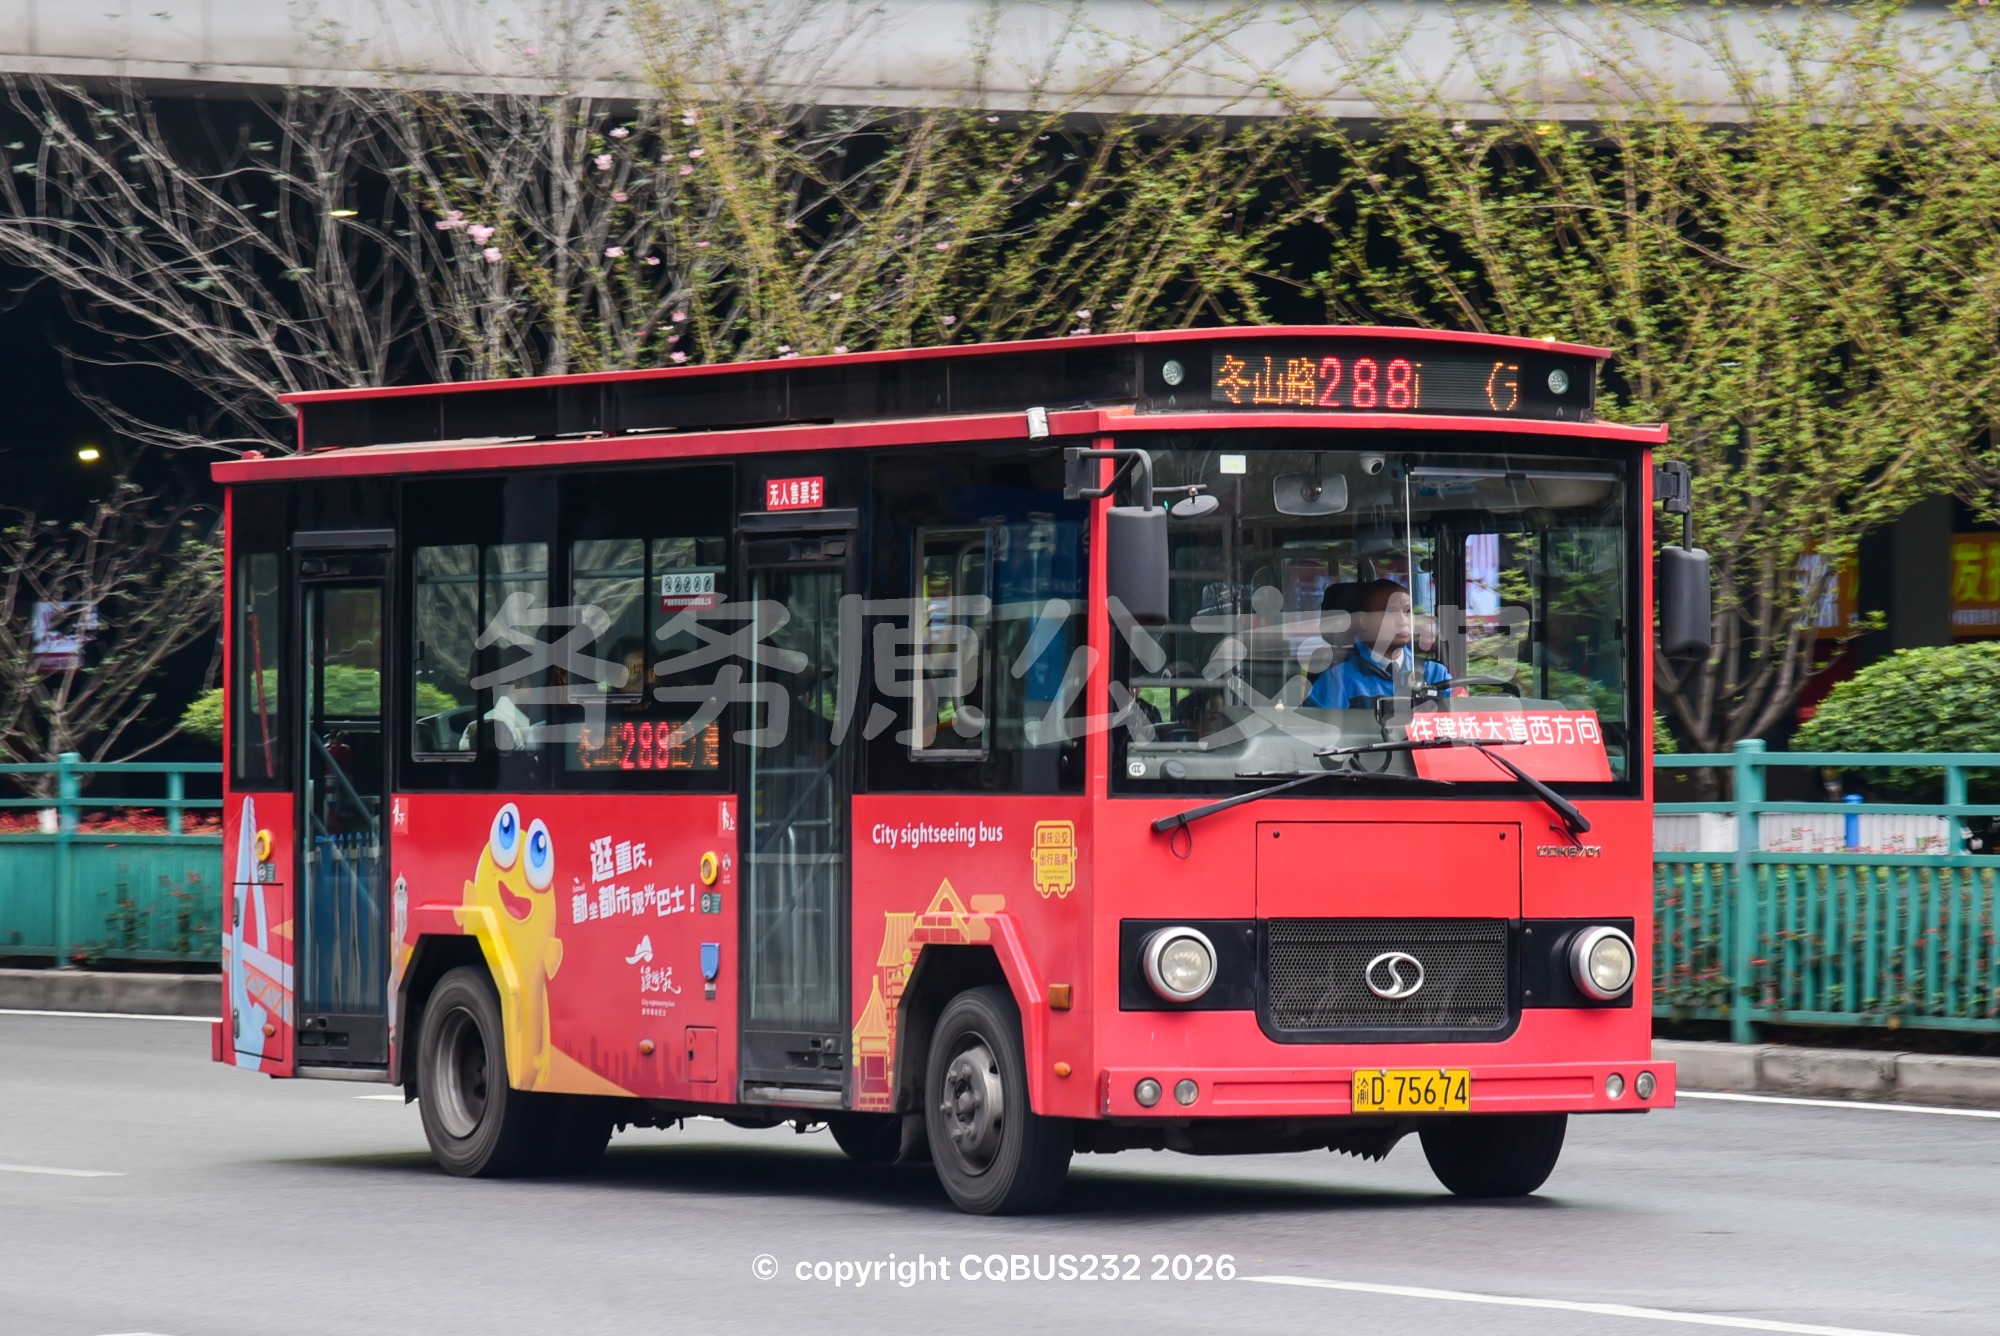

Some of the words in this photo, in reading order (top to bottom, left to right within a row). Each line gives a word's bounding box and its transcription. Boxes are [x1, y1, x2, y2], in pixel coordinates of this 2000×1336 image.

[1318, 356, 1412, 408] 288
[769, 480, 820, 506] 无人售票车
[1410, 713, 1601, 745] 往建桥大道西方向
[620, 721, 670, 769] 288
[872, 823, 899, 849] City
[900, 821, 976, 849] sightseeing
[979, 821, 1003, 842] bus
[1039, 831, 1069, 845] 重庆公交
